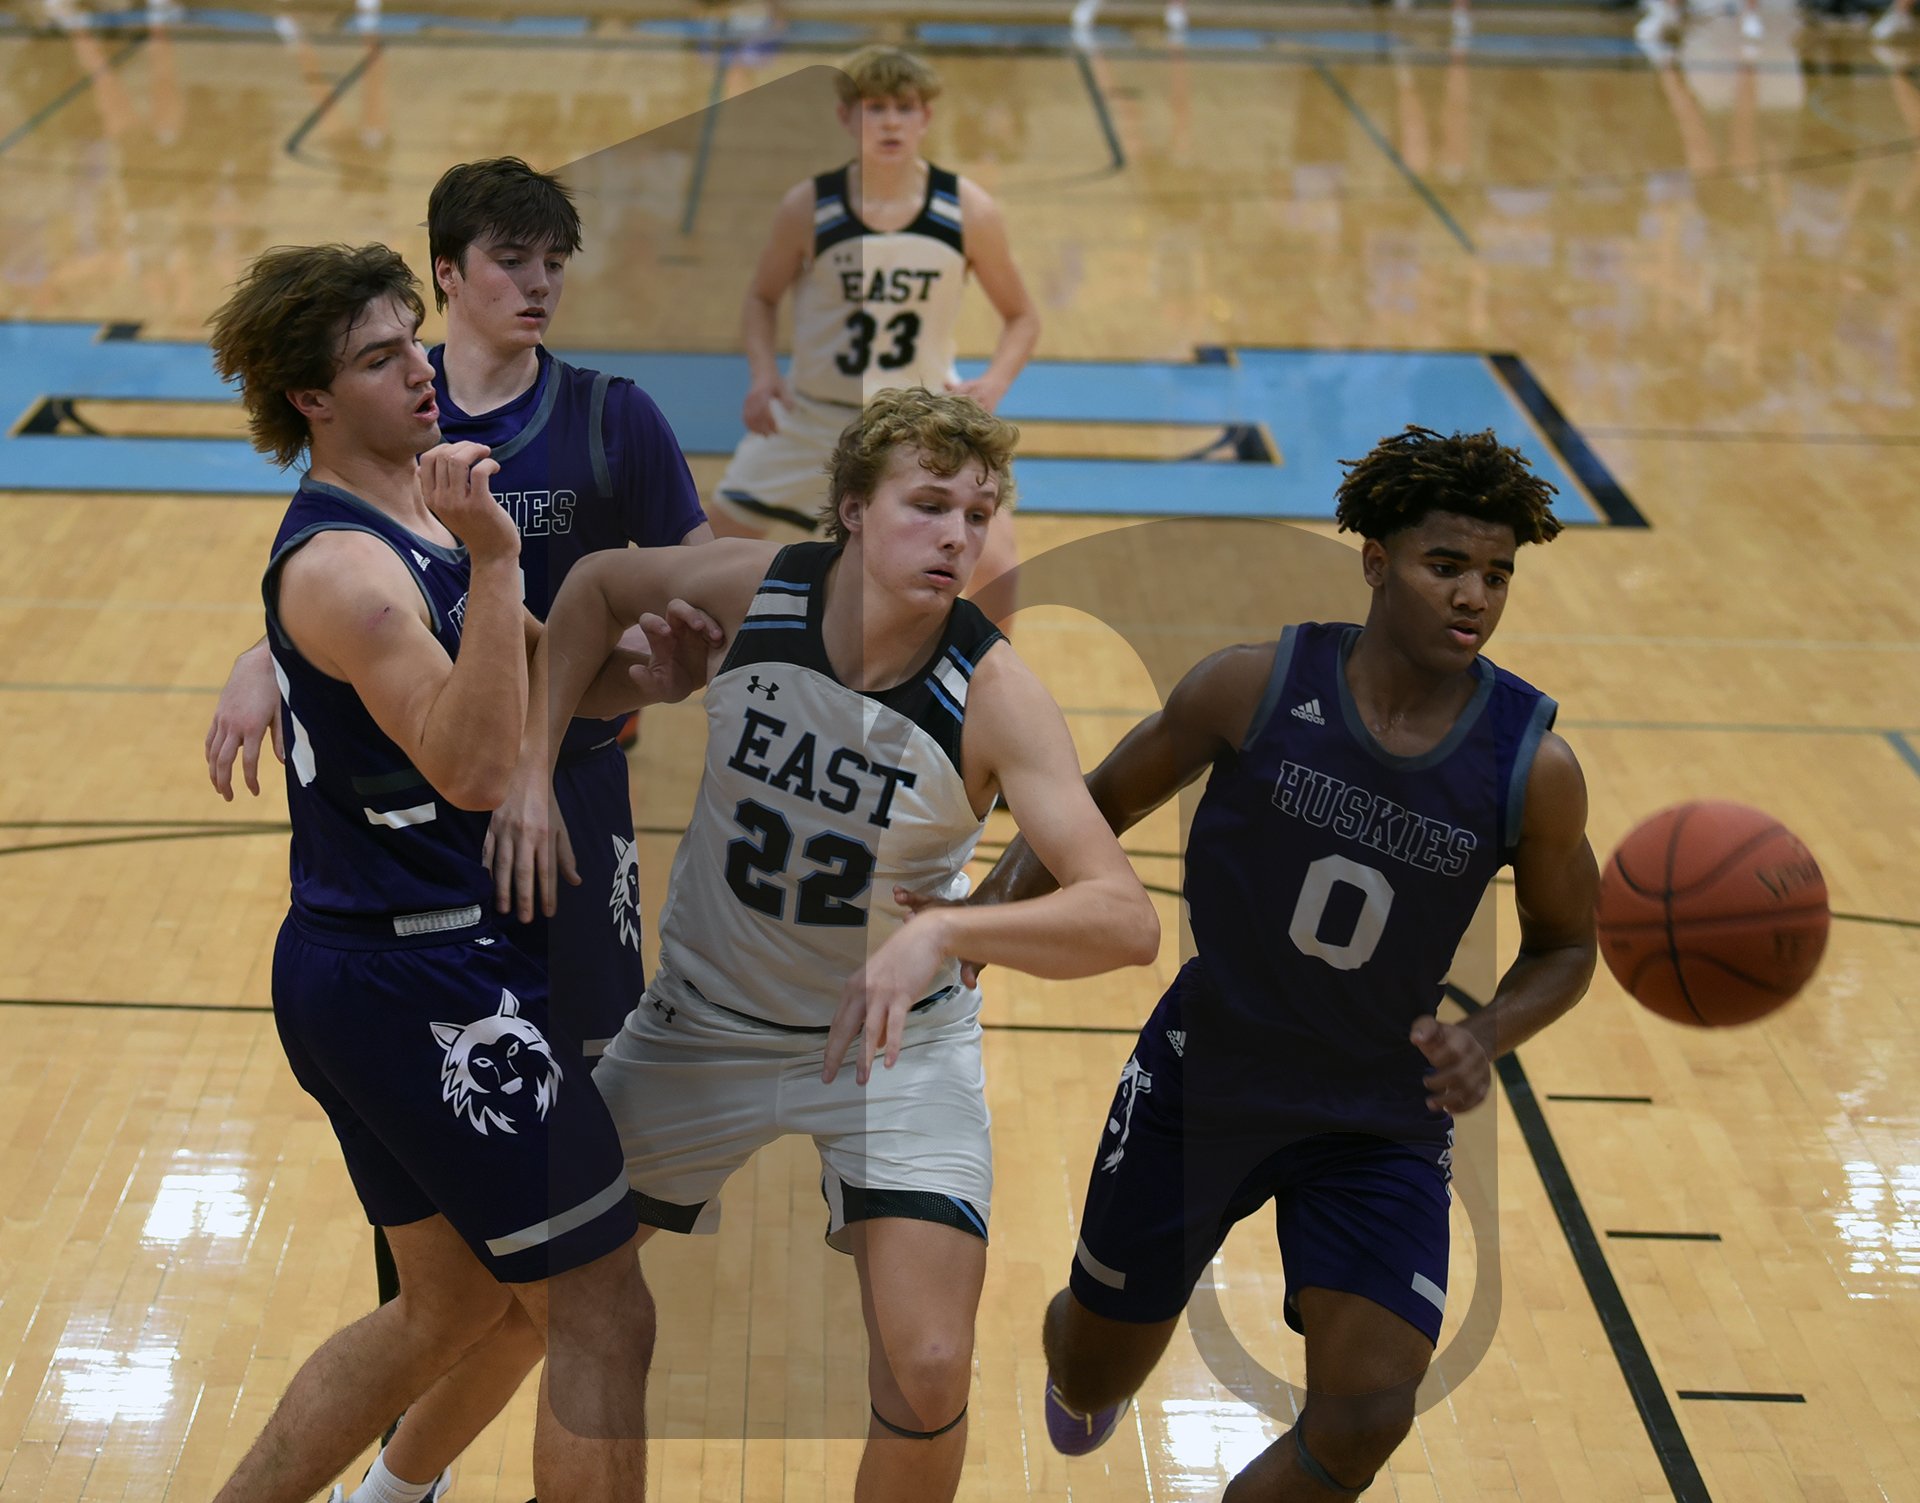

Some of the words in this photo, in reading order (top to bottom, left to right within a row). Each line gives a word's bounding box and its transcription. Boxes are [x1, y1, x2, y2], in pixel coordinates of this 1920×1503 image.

[834, 310, 921, 377] 33
[840, 268, 941, 303] EAST
[727, 707, 918, 830] EAST
[1290, 708, 1326, 726] adidas
[724, 797, 878, 928] 22
[1271, 759, 1478, 878] HUSKIES
[1288, 853, 1396, 972] 0
